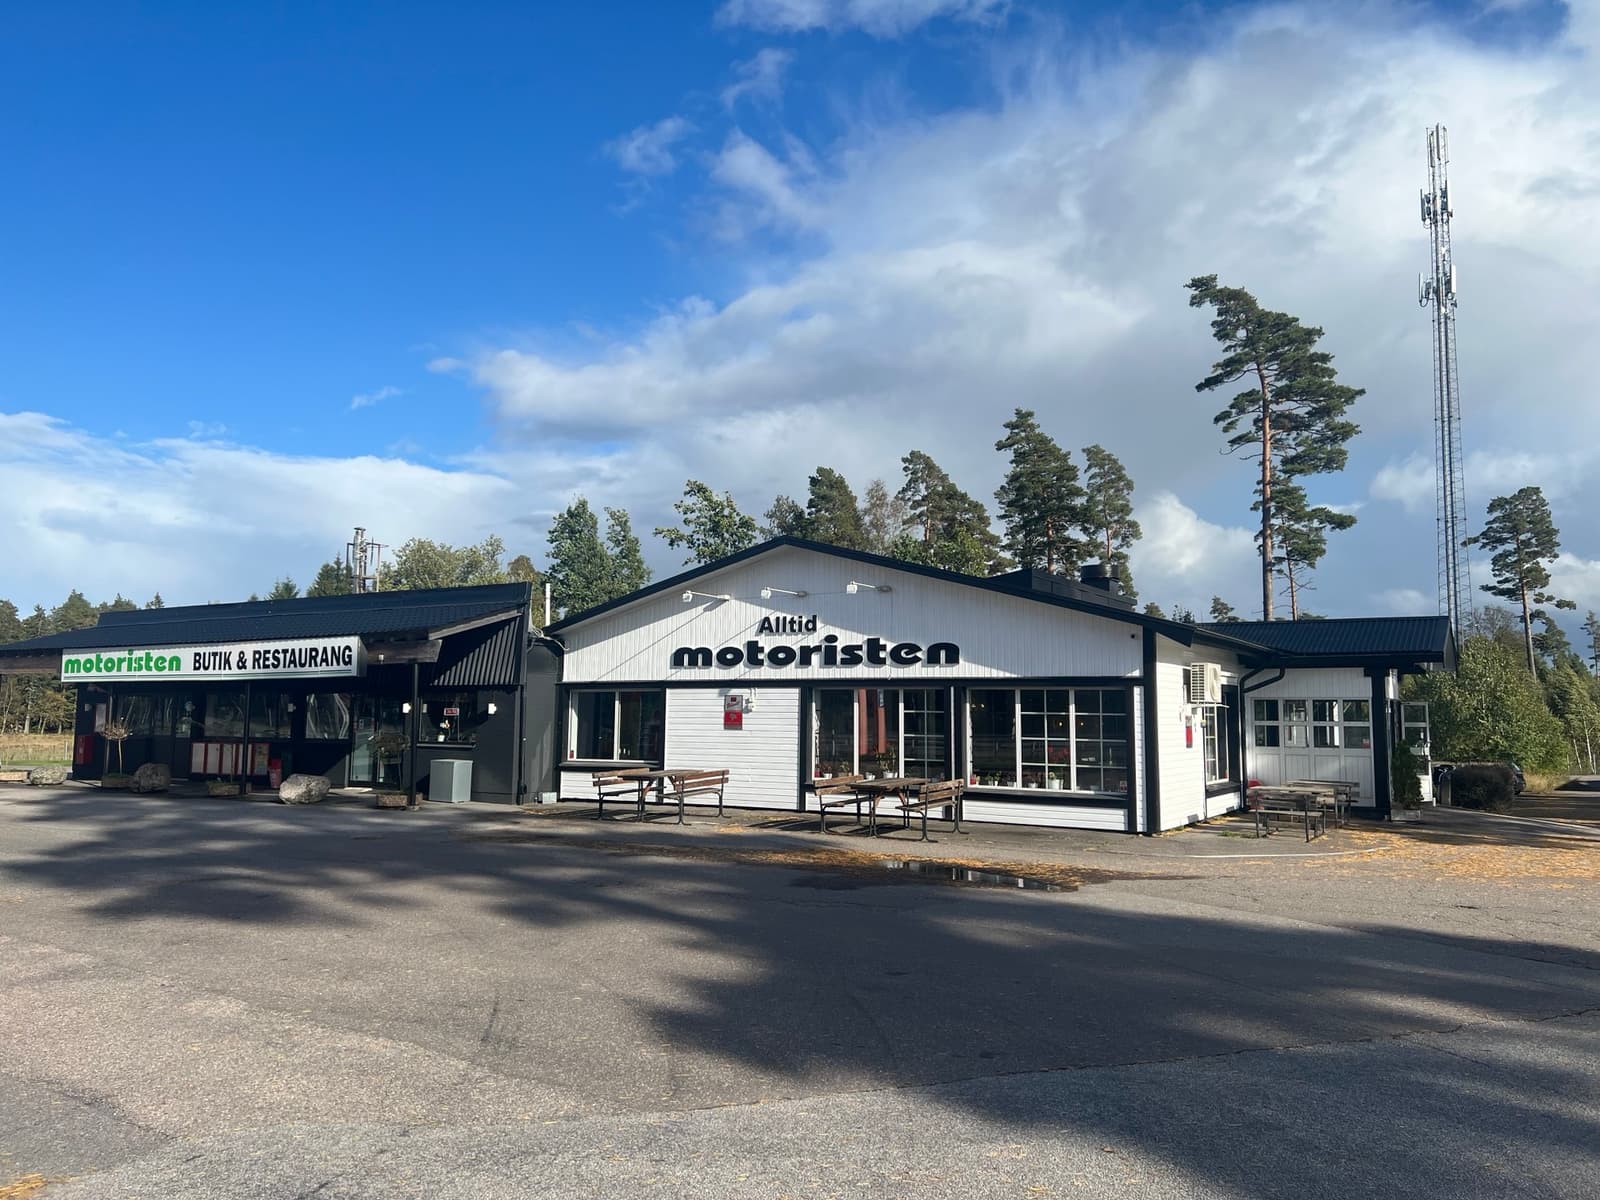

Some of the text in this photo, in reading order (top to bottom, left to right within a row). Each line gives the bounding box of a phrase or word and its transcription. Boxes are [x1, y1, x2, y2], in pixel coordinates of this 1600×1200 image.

[759, 615, 818, 633] Alltid
[64, 645, 353, 673] motoristen BUTIK & RESTAURANG
[673, 634, 960, 666] motoristen
